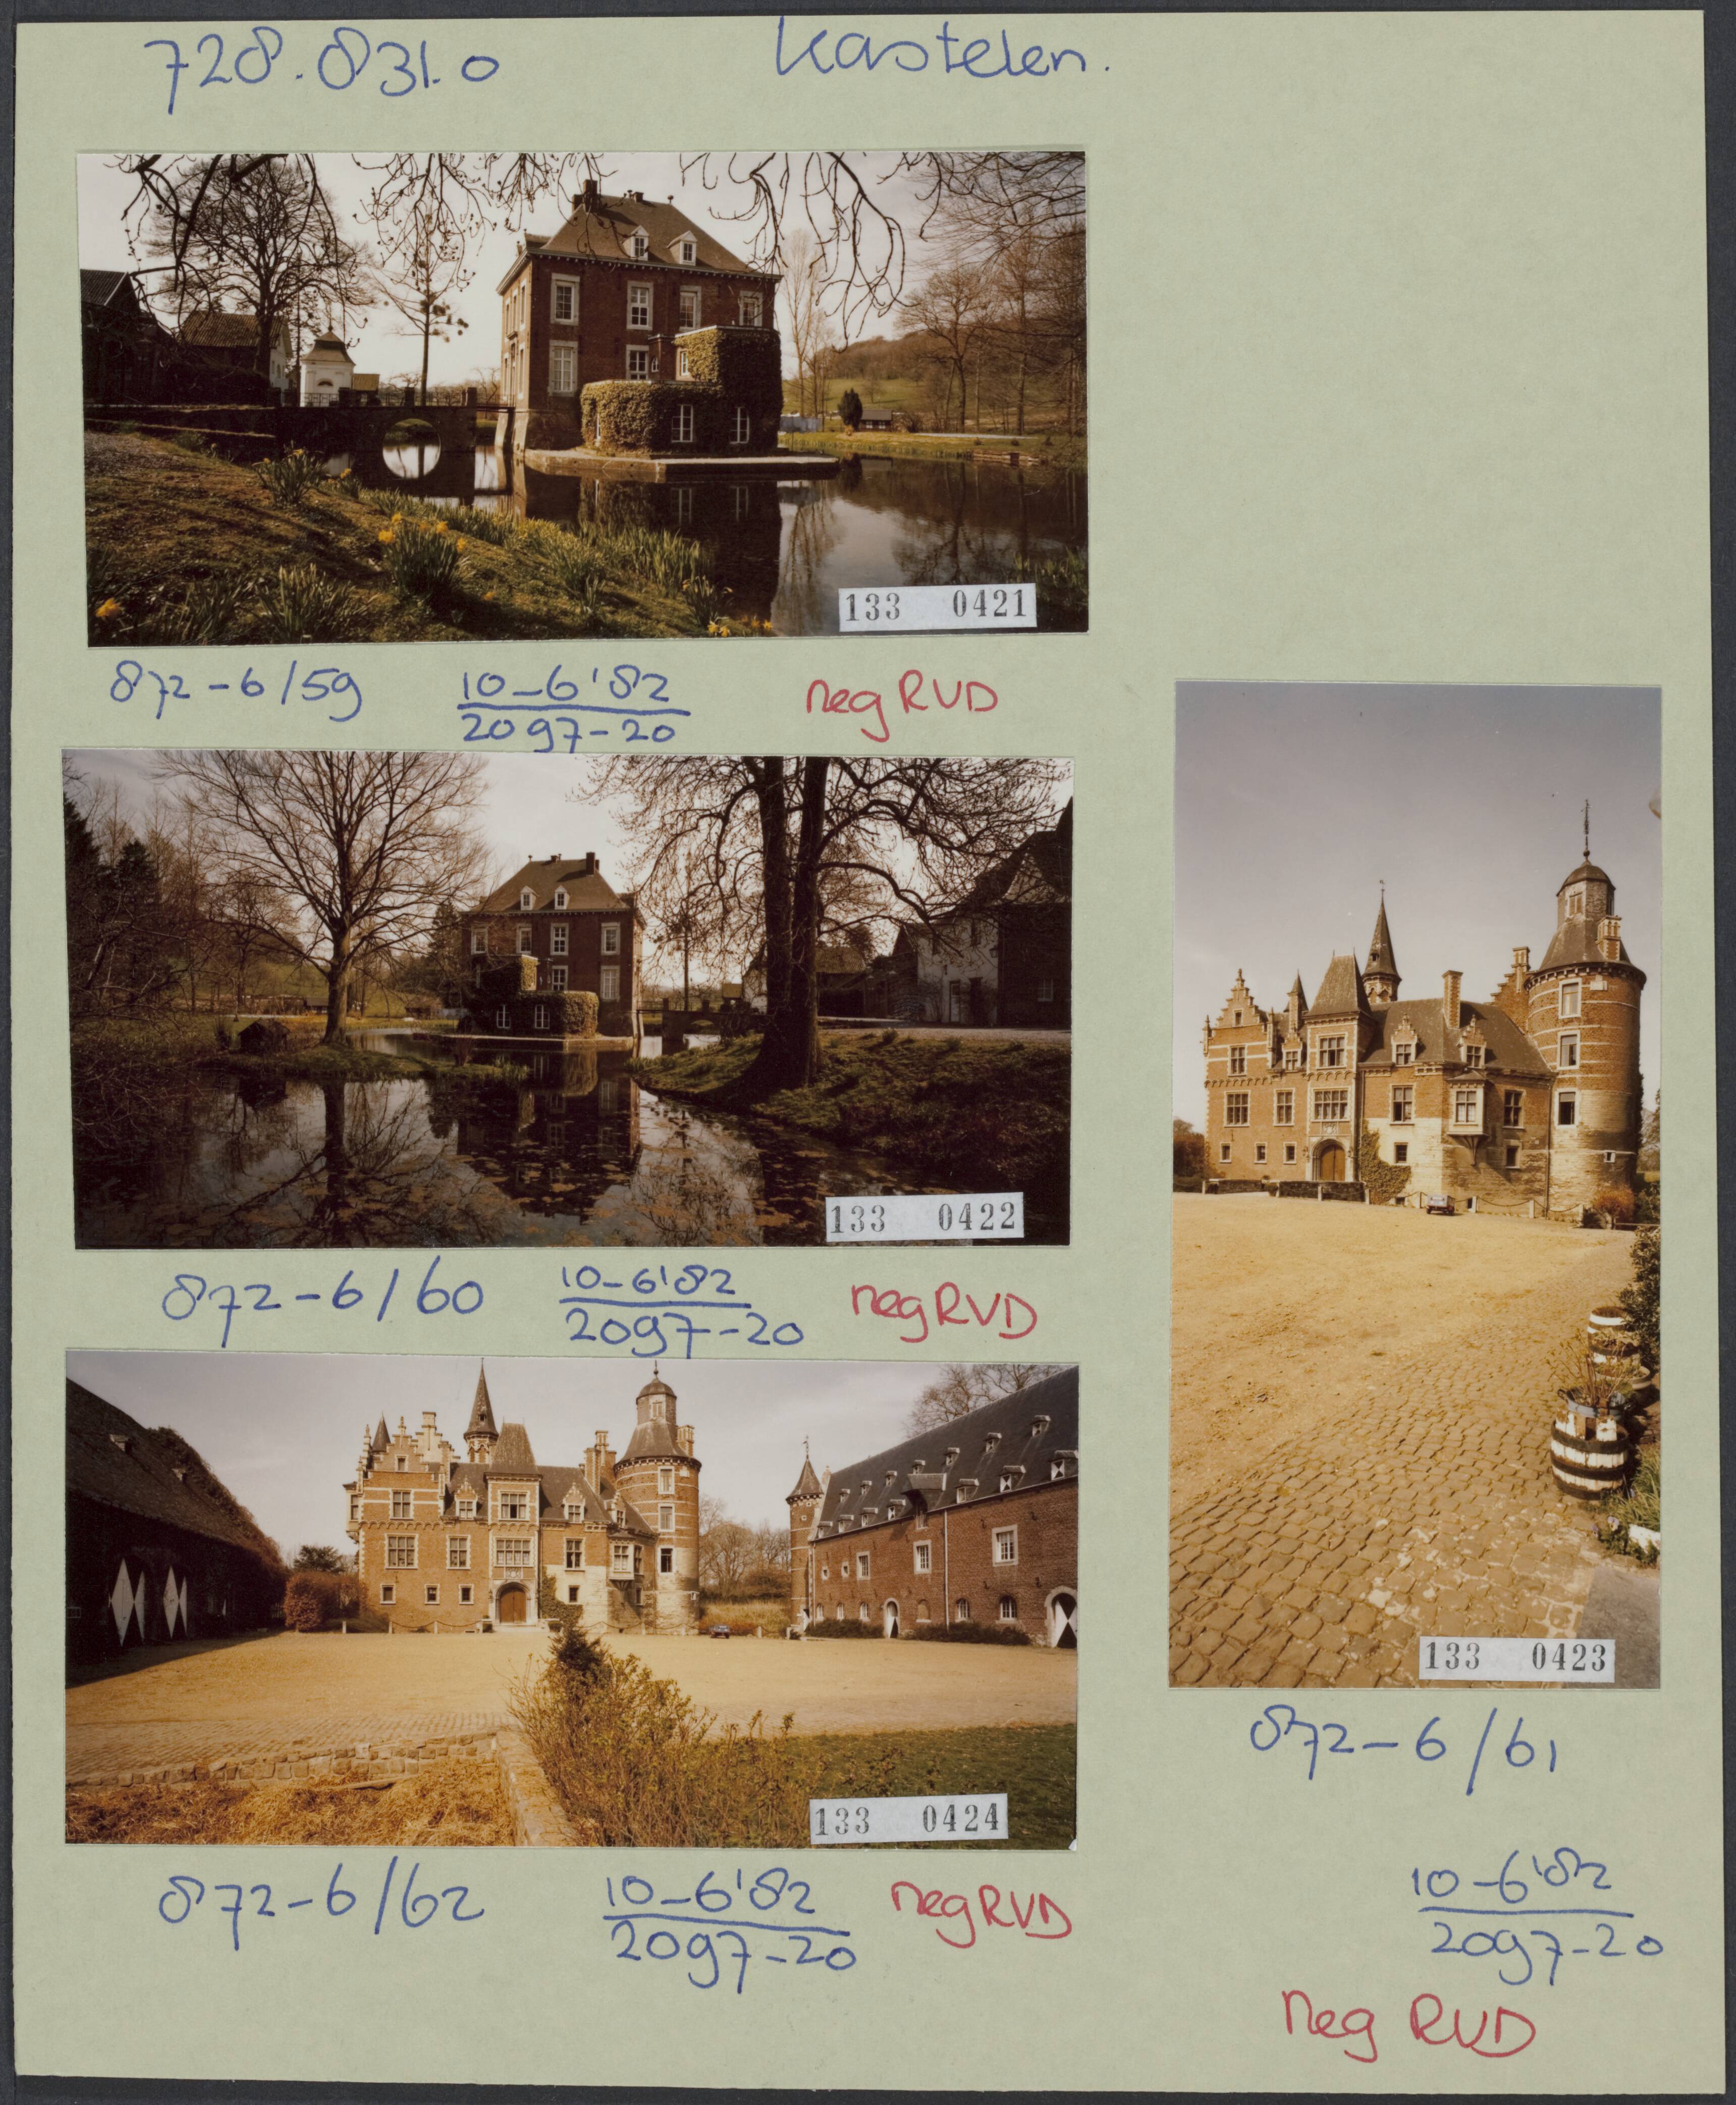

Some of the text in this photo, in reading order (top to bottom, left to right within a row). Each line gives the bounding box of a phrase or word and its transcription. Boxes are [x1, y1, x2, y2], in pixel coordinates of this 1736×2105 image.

[144, 26, 500, 116] 728.831.0
[845, 589, 1026, 621] 133 0421
[110, 659, 362, 723] 872-6/59
[806, 669, 998, 743] neg RVD
[460, 712, 676, 755] 2097-20
[830, 1202, 1015, 1233] 133 0422
[162, 1255, 484, 1349] 872-6/60
[565, 1307, 804, 1359] 2097-20
[851, 1285, 929, 1343] neg
[1425, 1642, 1606, 1671] 133 0423
[815, 1803, 999, 1835] 133 0424
[158, 1855, 485, 1952] 872-6/62
[891, 1881, 976, 1949] neg
[617, 1921, 856, 1995] 2097-20
[1431, 1922, 1664, 1986] 2097-20
[1281, 1990, 1536, 2063] neg RVD
